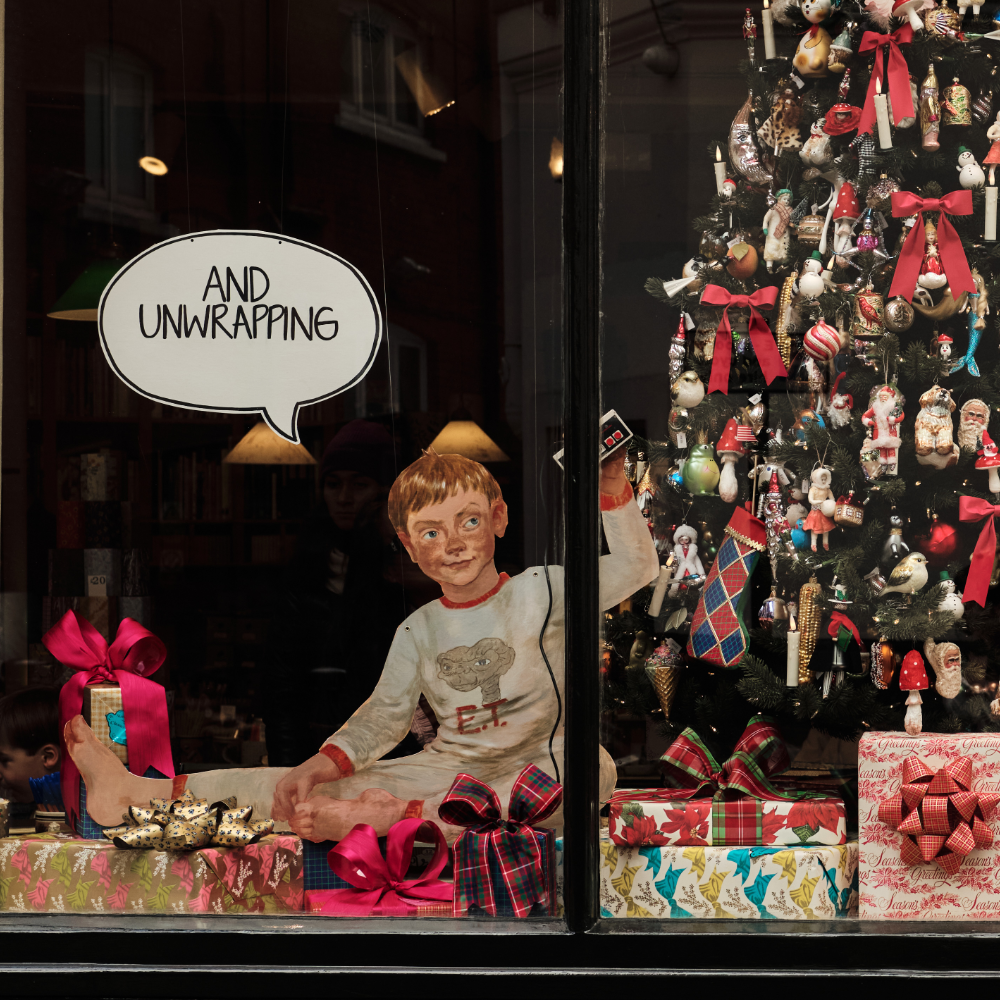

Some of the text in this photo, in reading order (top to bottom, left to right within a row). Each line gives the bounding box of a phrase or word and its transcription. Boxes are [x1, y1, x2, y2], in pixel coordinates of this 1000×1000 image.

[202, 265, 270, 303] AND
[138, 303, 339, 341] UNWRAPPING
[456, 698, 508, 735] E.T.
